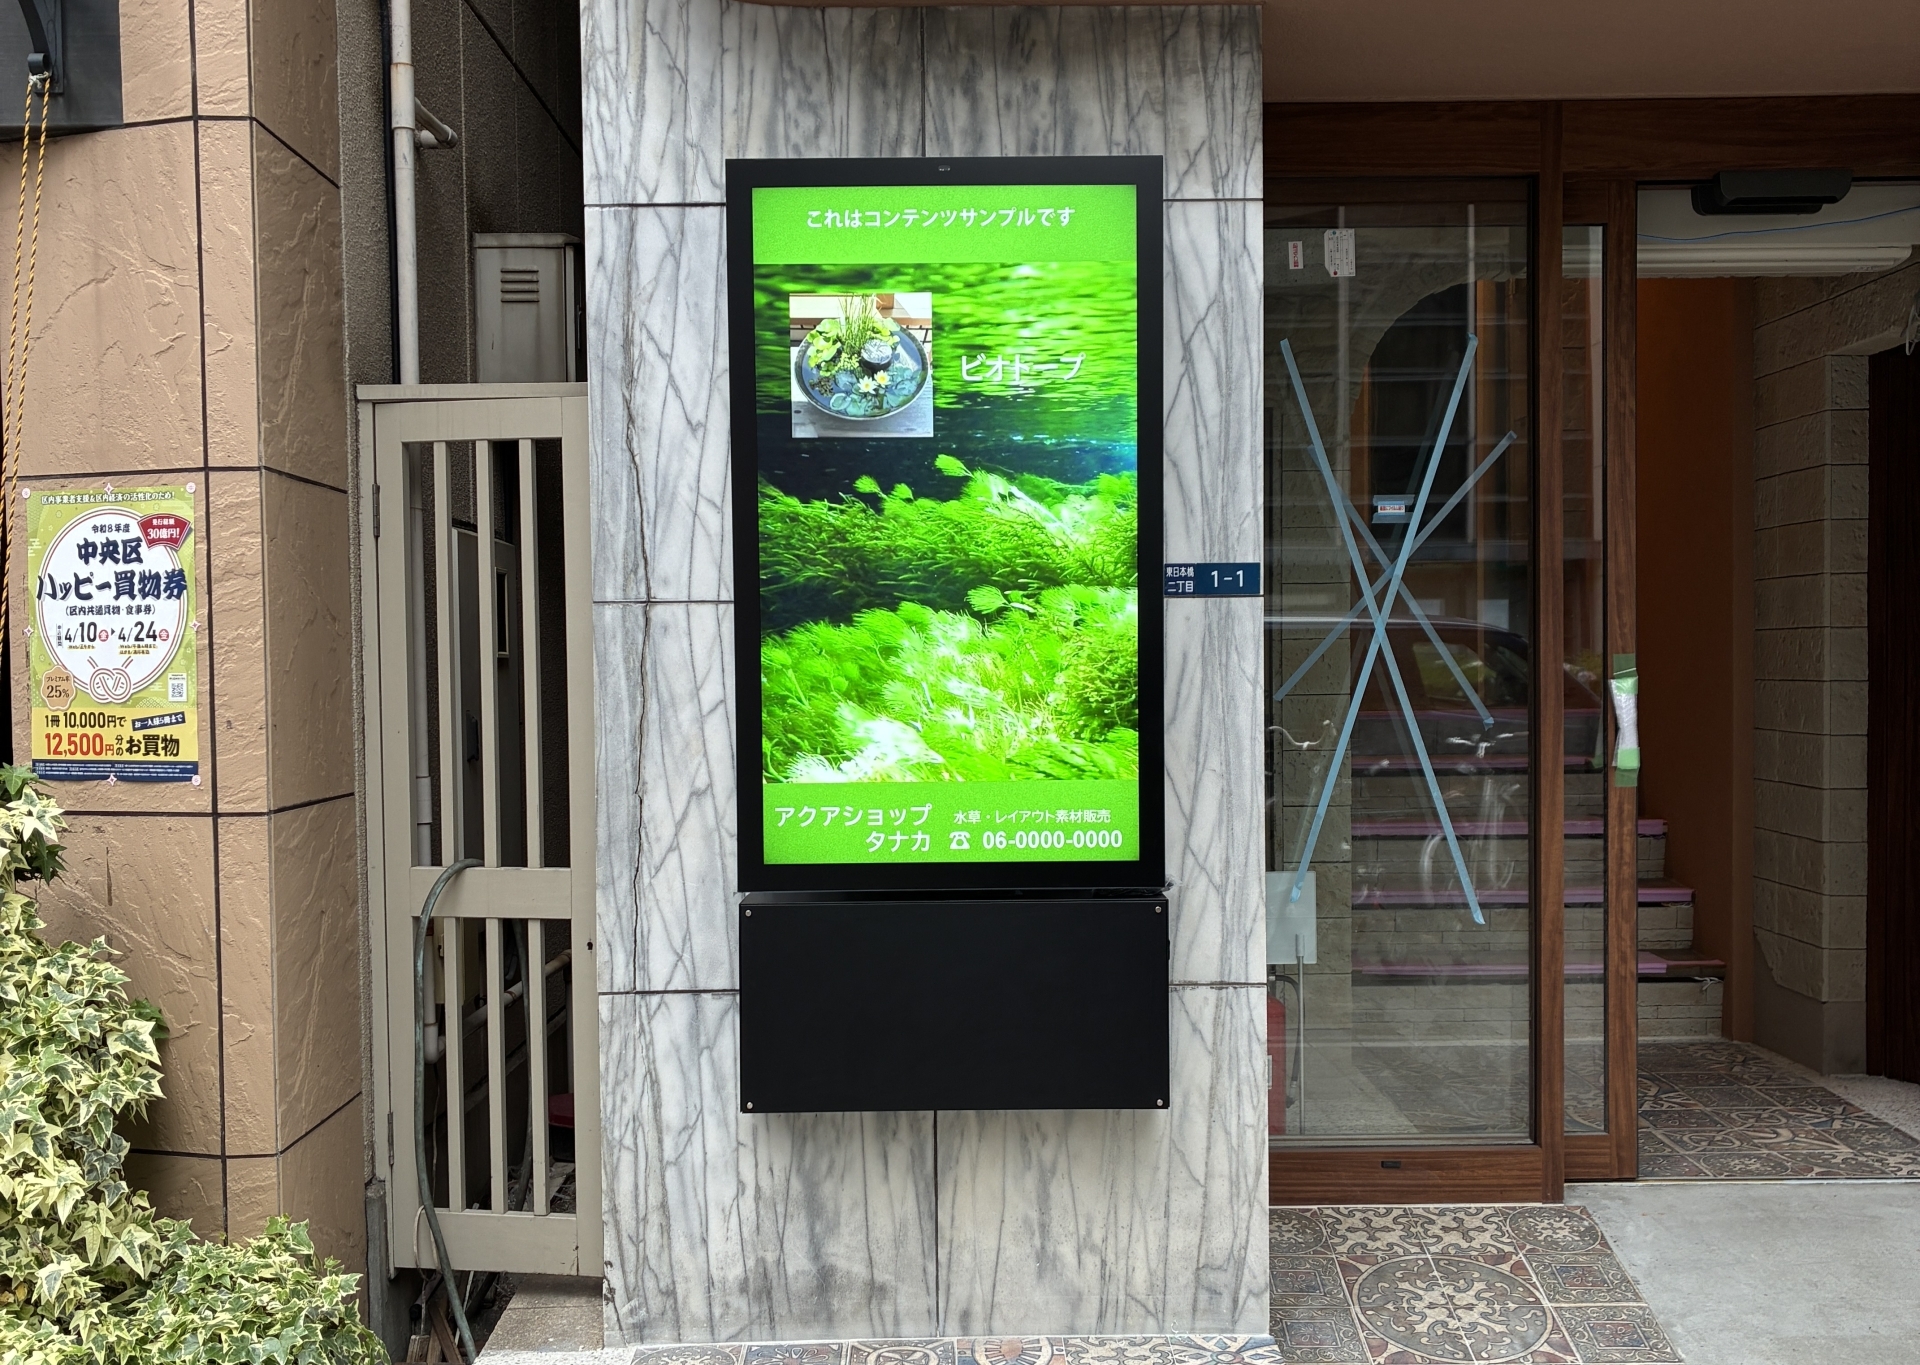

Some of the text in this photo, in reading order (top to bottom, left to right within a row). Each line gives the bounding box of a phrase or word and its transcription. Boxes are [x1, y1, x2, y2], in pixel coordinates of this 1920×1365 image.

[806, 206, 1076, 229] これはコンテンツサンプルです
[960, 351, 1087, 383] ビオトープ
[91, 523, 131, 534] 令和8年度
[147, 527, 180, 540] 30億円!
[76, 536, 143, 566] 中央区
[1166, 566, 1195, 578] 東日本橋
[1210, 569, 1244, 588] 1-1
[36, 568, 187, 601] ハッピー買物券
[1167, 580, 1194, 593] 二丁目
[64, 621, 98, 643] 4/10
[118, 620, 157, 642] 4/24
[46, 684, 70, 699] 25%
[774, 803, 933, 828] アクアショップ
[953, 809, 1112, 825] 水草・レイアウト素材販売
[864, 830, 932, 853] タナカ
[982, 829, 1123, 850] 06-0000-0000
